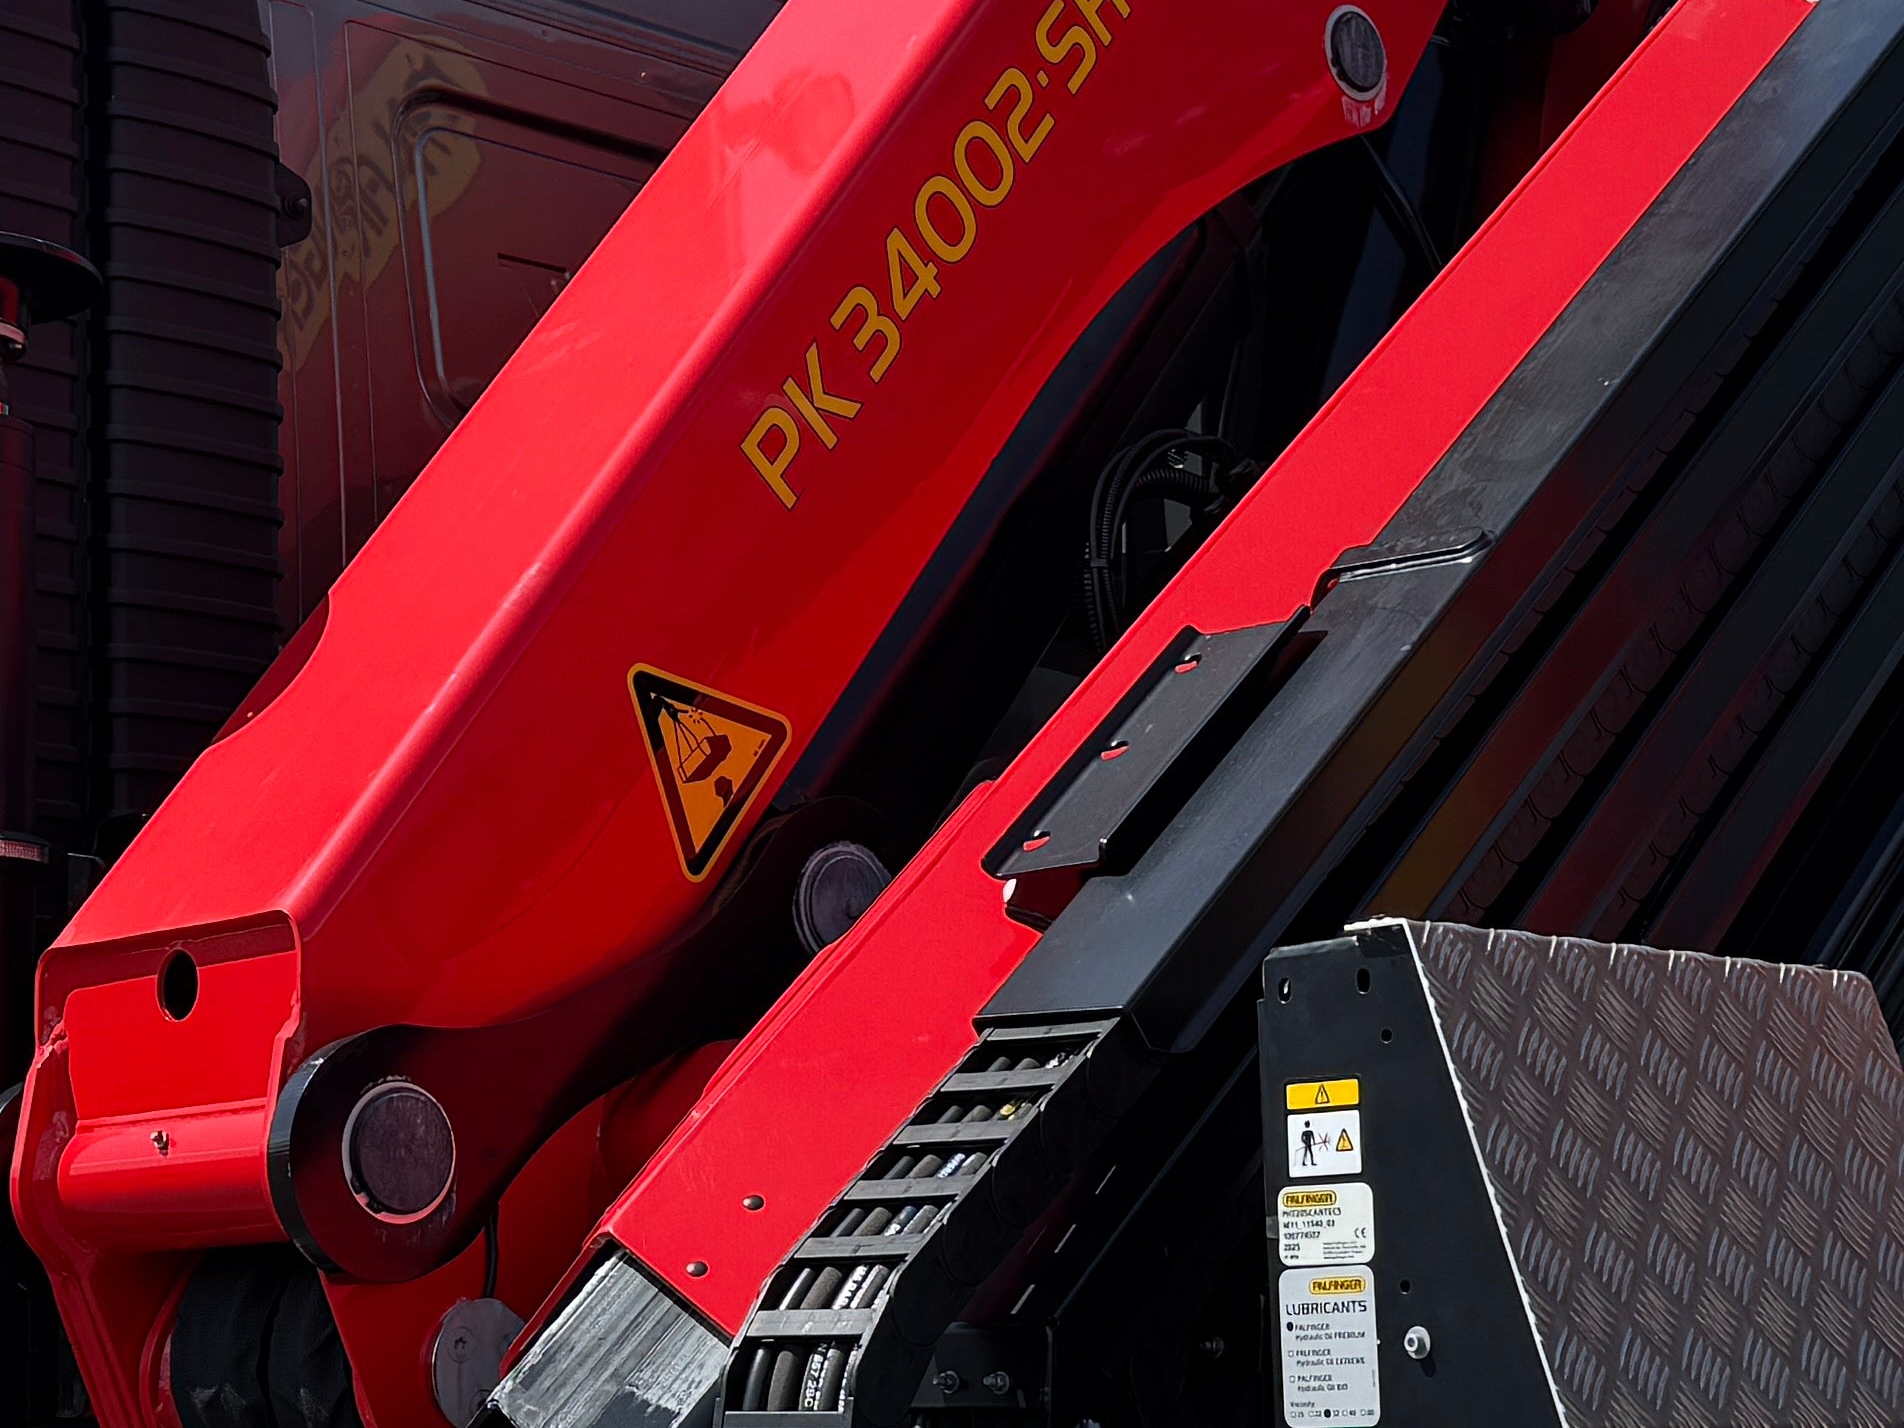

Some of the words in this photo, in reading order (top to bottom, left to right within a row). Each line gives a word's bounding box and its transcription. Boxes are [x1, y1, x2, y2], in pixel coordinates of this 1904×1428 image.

[741, 342, 864, 510] PK
[1313, 1279, 1362, 1292] PALFINGER
[1286, 1300, 1367, 1316] LUBRICANTS
